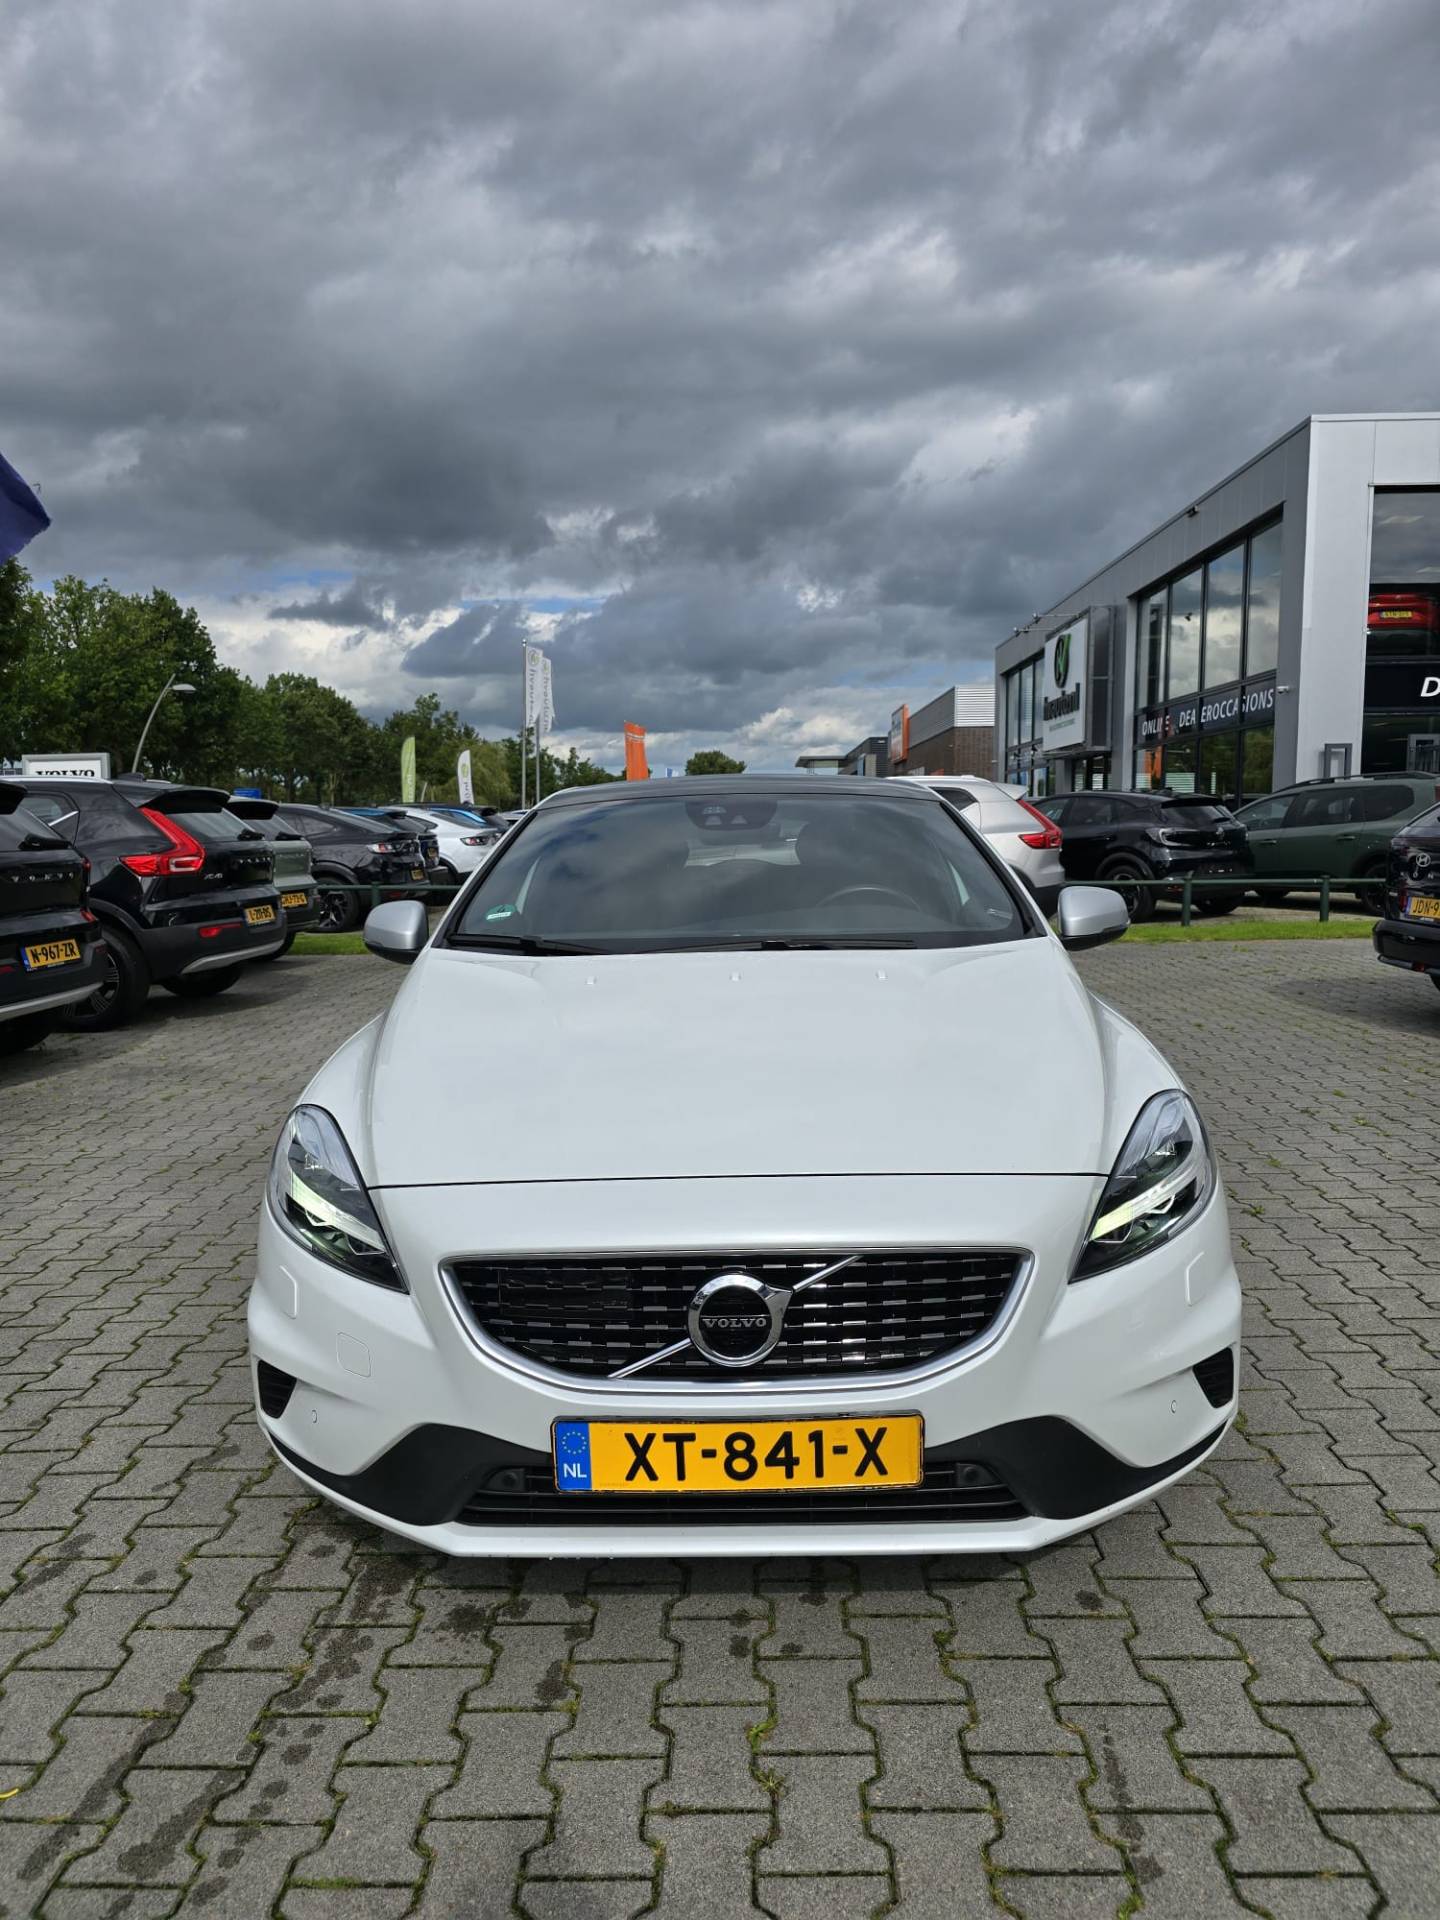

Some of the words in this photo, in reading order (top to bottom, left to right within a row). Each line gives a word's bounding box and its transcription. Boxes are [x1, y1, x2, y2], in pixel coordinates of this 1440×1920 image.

[1178, 688, 1274, 728] DEAEROCCAIONS
[30, 943, 77, 963] N-967-ZR
[702, 1317, 767, 1328] VOLVO
[624, 1427, 888, 1482] XT-841-X
[563, 1463, 587, 1479] NL
